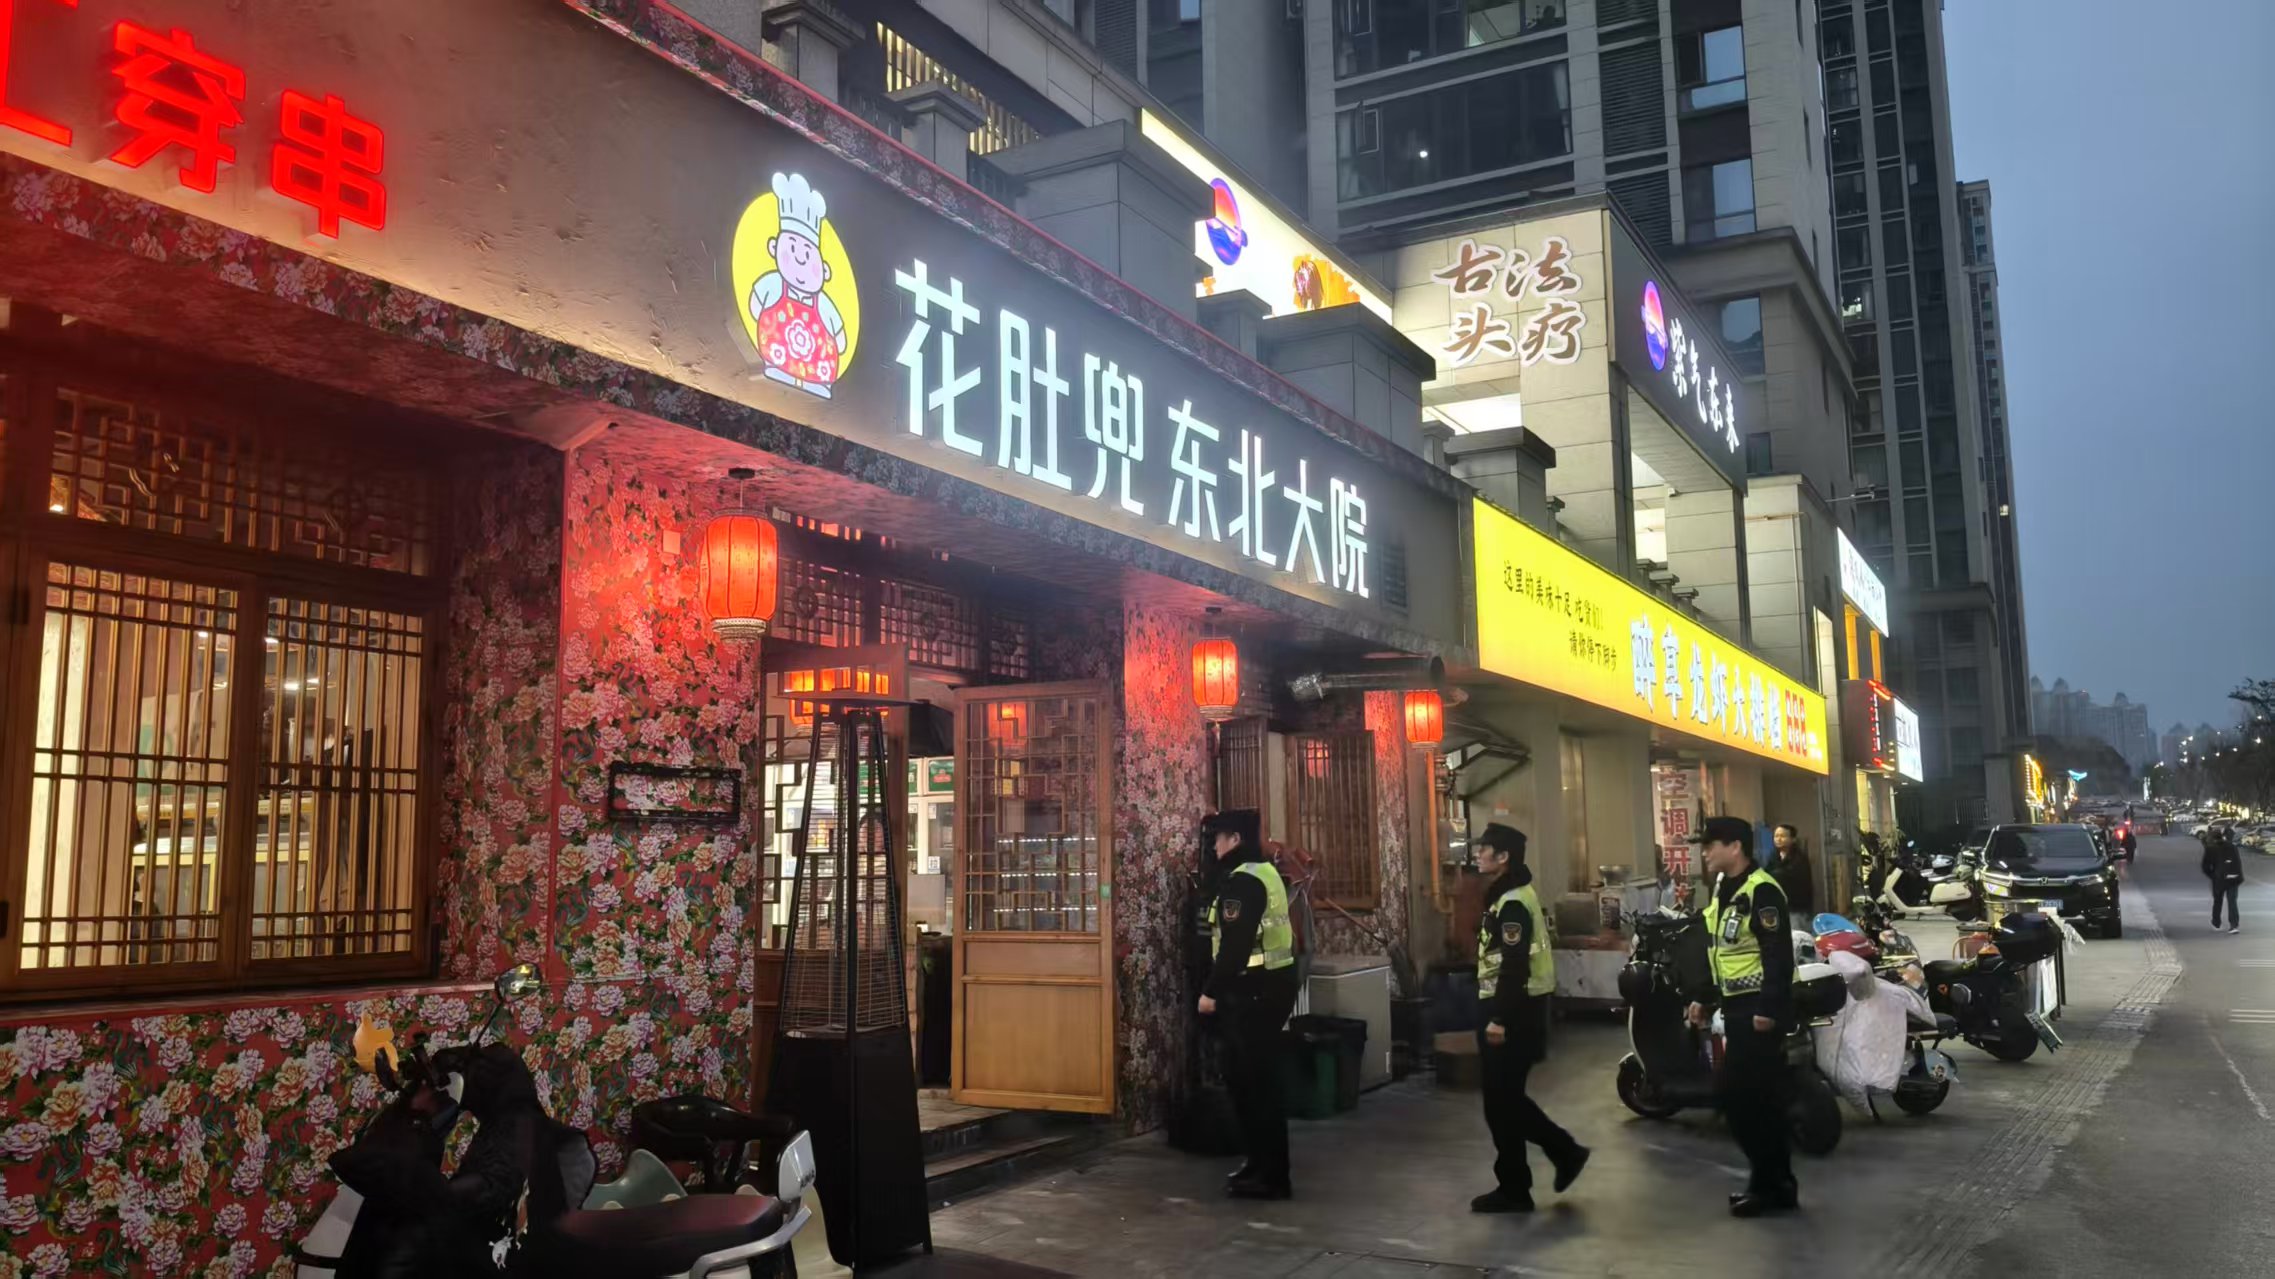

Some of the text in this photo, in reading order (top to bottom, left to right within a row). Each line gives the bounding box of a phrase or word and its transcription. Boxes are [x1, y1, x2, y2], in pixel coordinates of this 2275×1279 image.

[1432, 238, 1580, 299] 古法
[1442, 300, 1584, 363] 头疗
[894, 258, 1370, 599] 花肚兜 东北大院
